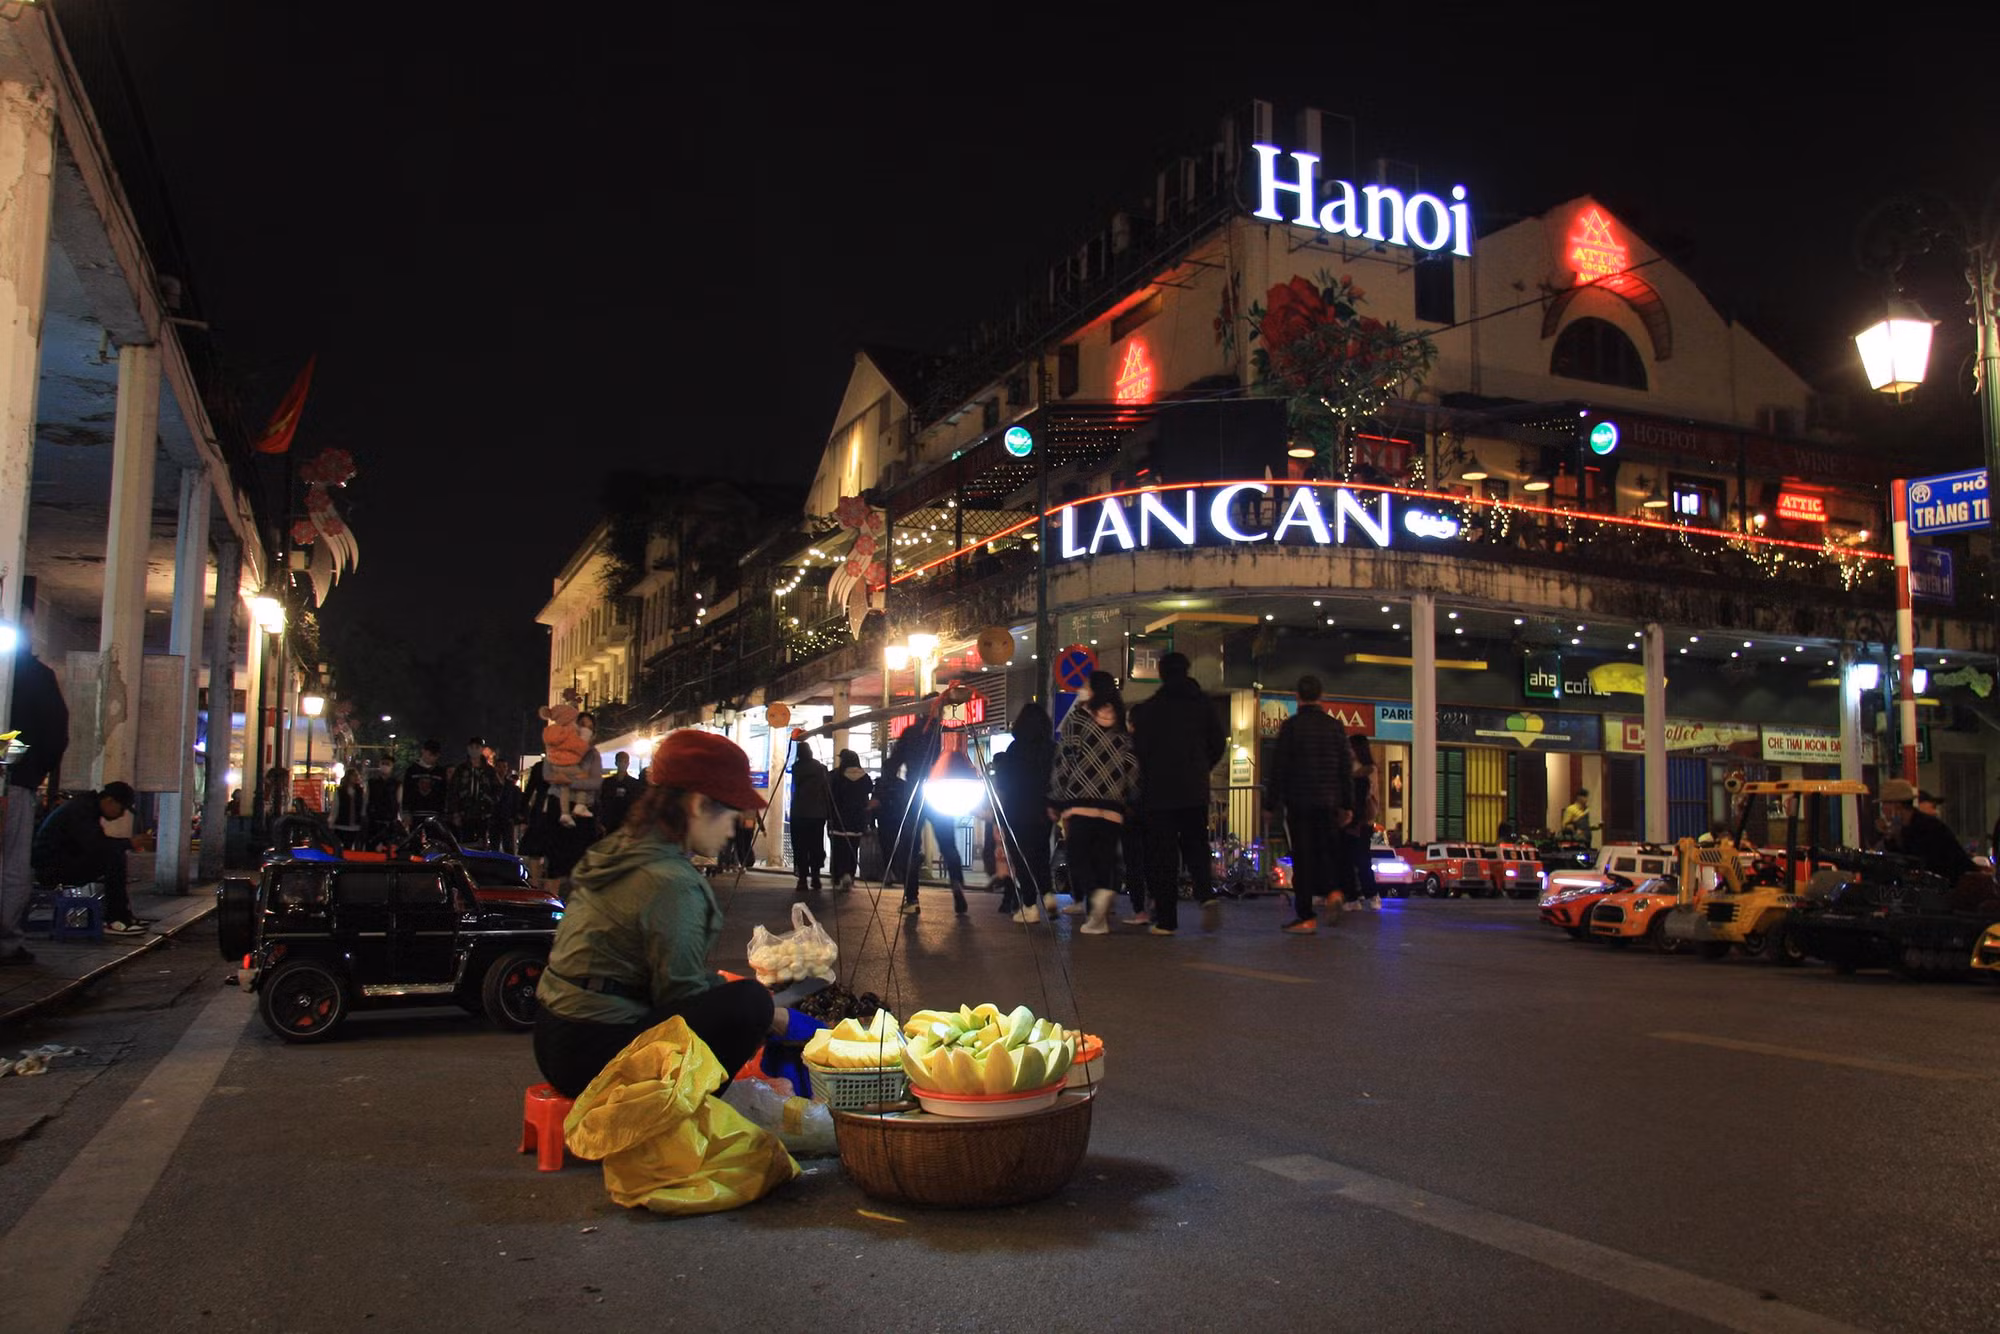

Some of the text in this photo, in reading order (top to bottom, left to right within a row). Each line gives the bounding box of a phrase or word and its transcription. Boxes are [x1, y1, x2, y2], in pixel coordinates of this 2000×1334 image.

[1252, 144, 1472, 257] Hanoi
[1572, 247, 1626, 268] ATTIC
[1952, 472, 1988, 494] PHỐ
[1782, 496, 1822, 512] ATTIC
[1915, 498, 1990, 528] TRÀNG TI
[1062, 490, 1196, 559] LAN
[1210, 483, 1391, 548] CAN
[1529, 665, 1611, 697] aha coff
[1664, 726, 1698, 742] offee
